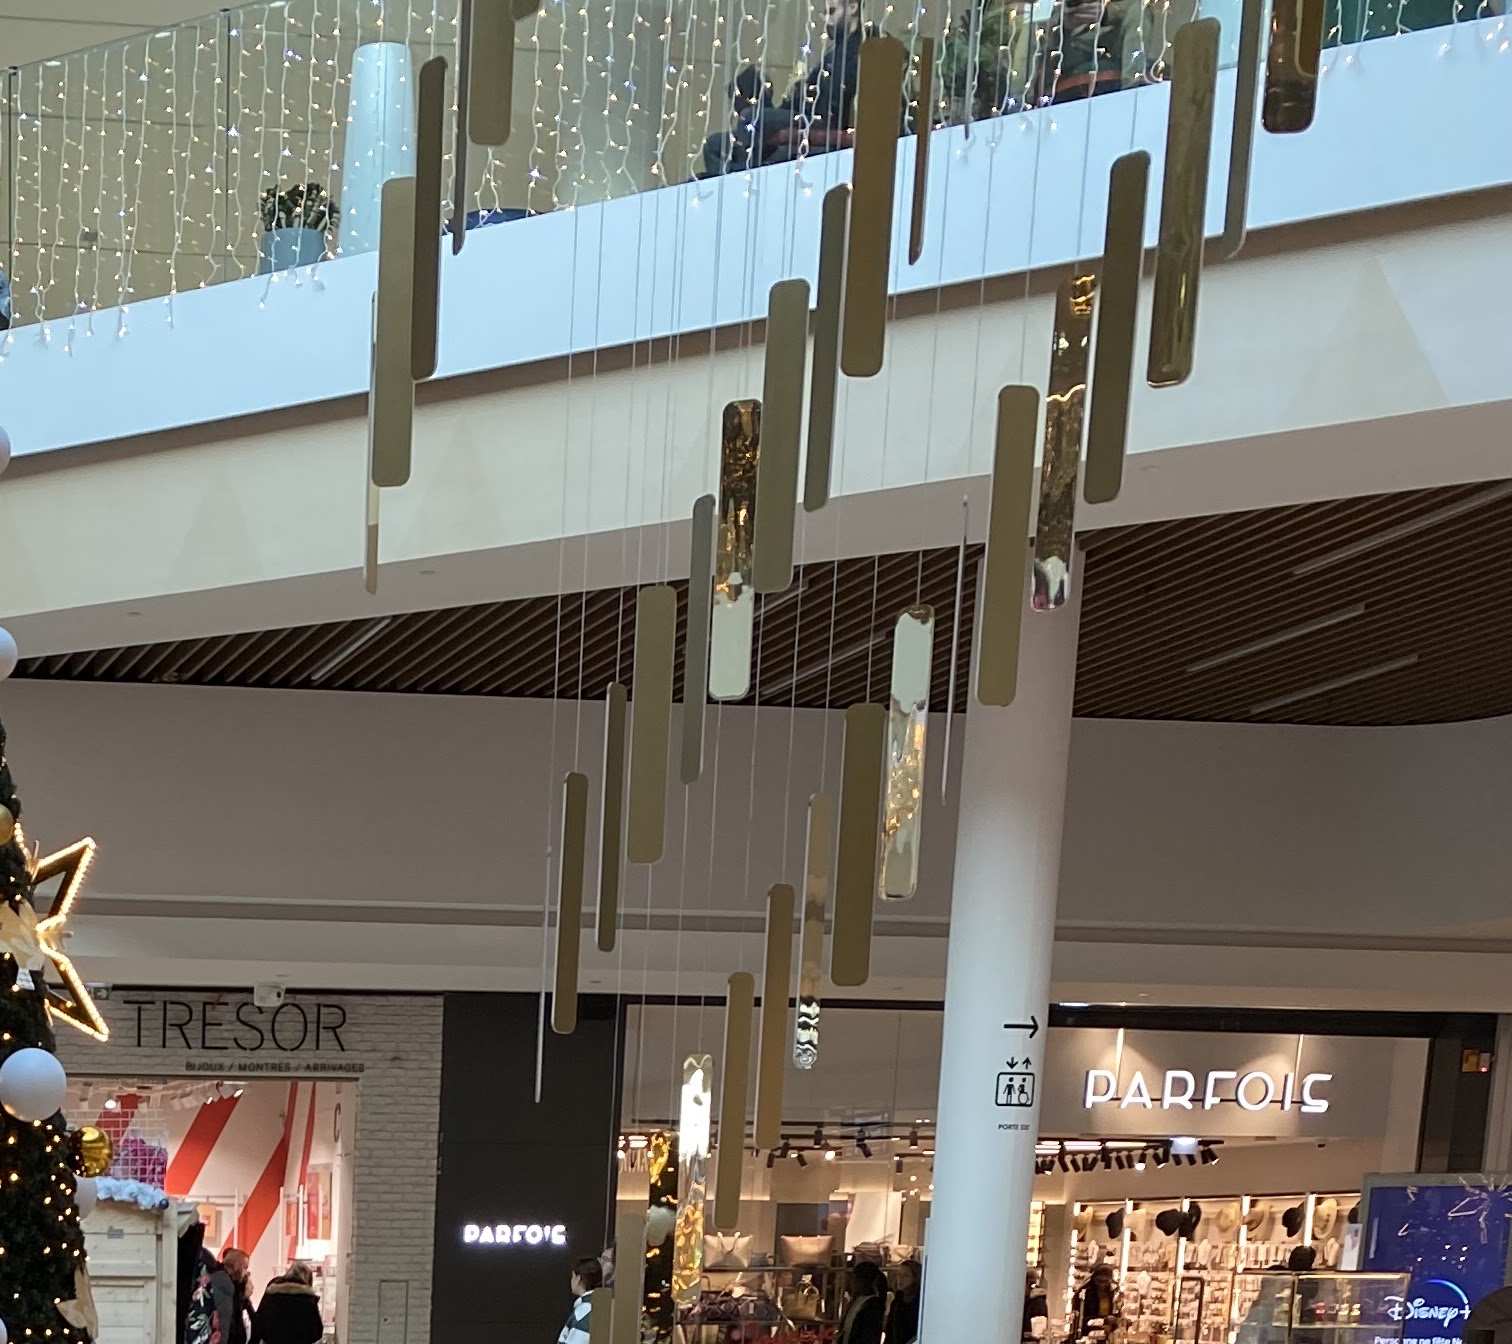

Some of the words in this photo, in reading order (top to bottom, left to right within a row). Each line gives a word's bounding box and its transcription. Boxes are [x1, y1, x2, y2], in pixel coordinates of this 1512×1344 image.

[123, 1000, 347, 1052] TRESOR
[185, 1061, 224, 1072] BIJOUX
[238, 1062, 291, 1072] MONTRES
[304, 1063, 365, 1073] ARRIVAGES
[1083, 1069, 1334, 1113] PARFOIS
[463, 1223, 567, 1245] PARFOIS
